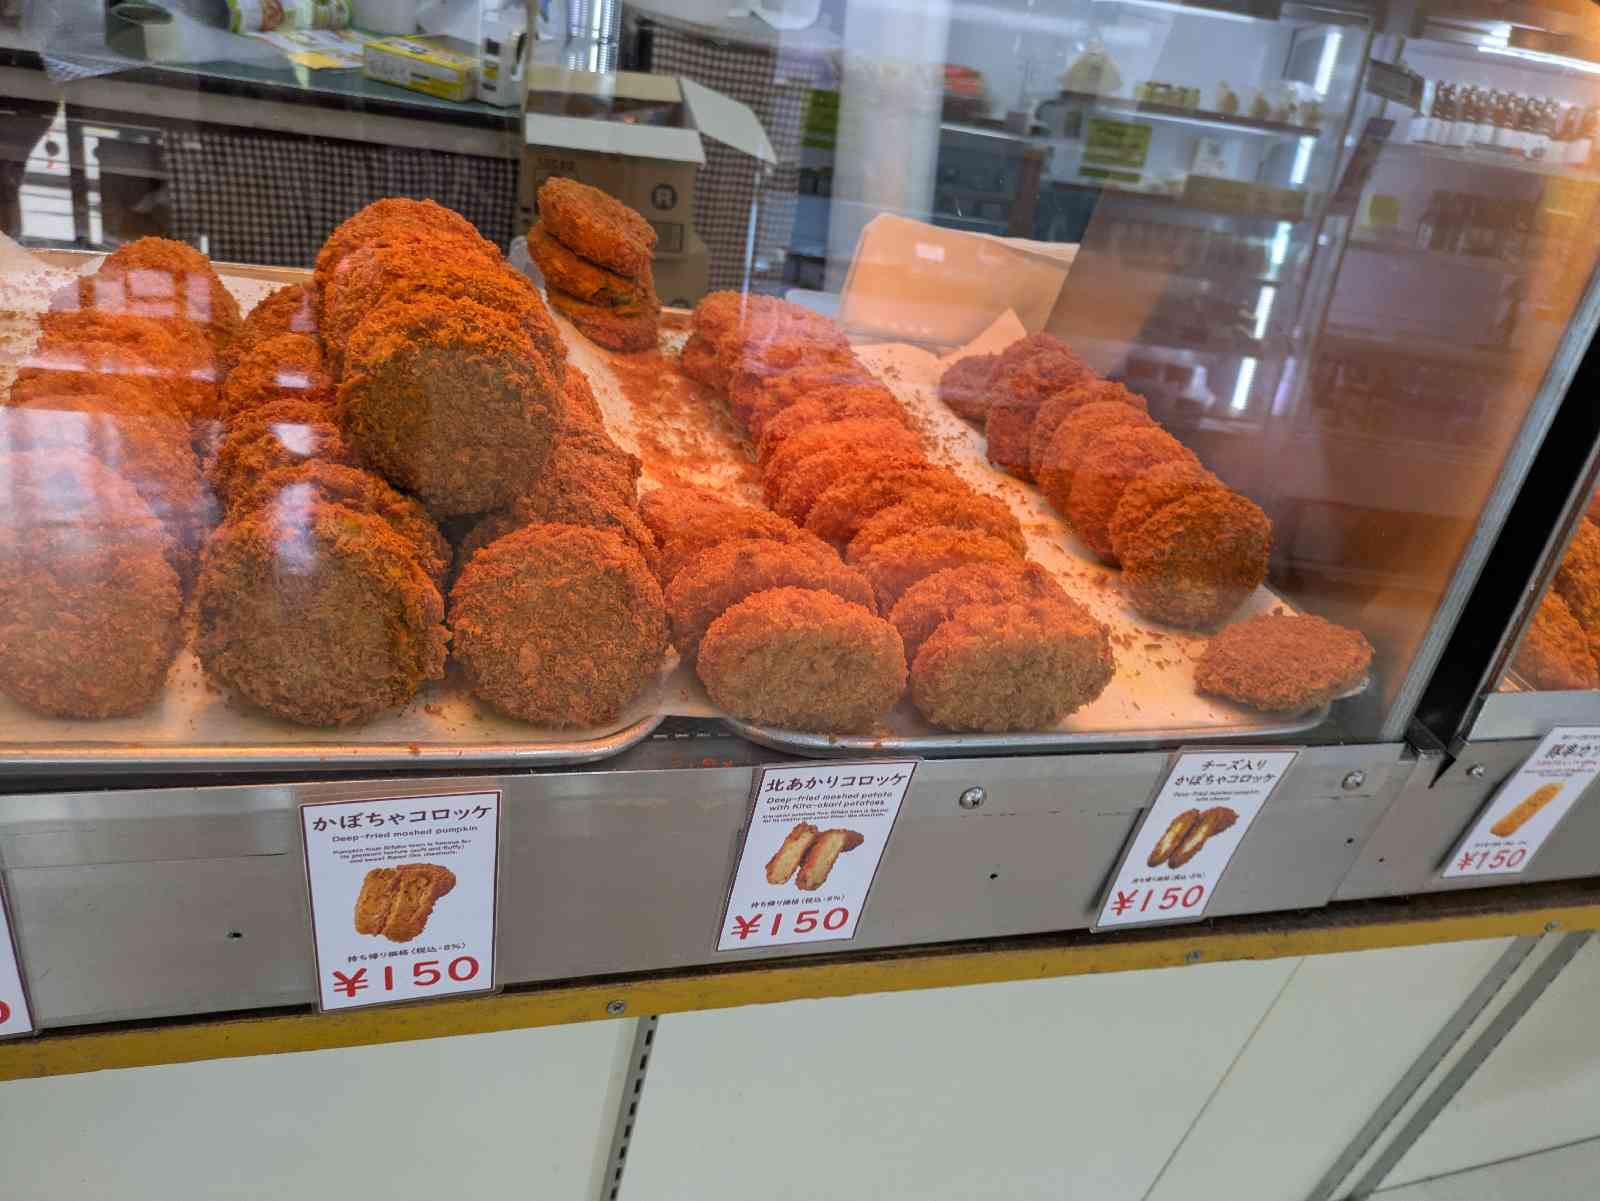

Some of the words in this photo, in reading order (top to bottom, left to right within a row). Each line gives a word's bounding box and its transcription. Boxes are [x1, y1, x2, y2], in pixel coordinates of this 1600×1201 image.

[1201, 759, 1270, 772] チーズ入り
[764, 772, 908, 793] 北あかりコロッケ
[1174, 772, 1277, 788] かぼちゃコロッケ
[766, 794, 821, 805] Deep-fried
[823, 792, 859, 802] mashed
[861, 791, 893, 801] potato
[769, 803, 789, 812] with
[844, 799, 885, 808] potatoes
[312, 804, 493, 832] かぼちゃコロッケ
[332, 830, 391, 844] Deep-fried
[393, 828, 432, 838] mashed
[435, 825, 478, 835] pumpkin
[1458, 848, 1527, 871] ¥150
[1110, 883, 1205, 917] ¥150
[730, 907, 850, 941] ¥150
[332, 955, 480, 998] ¥150
